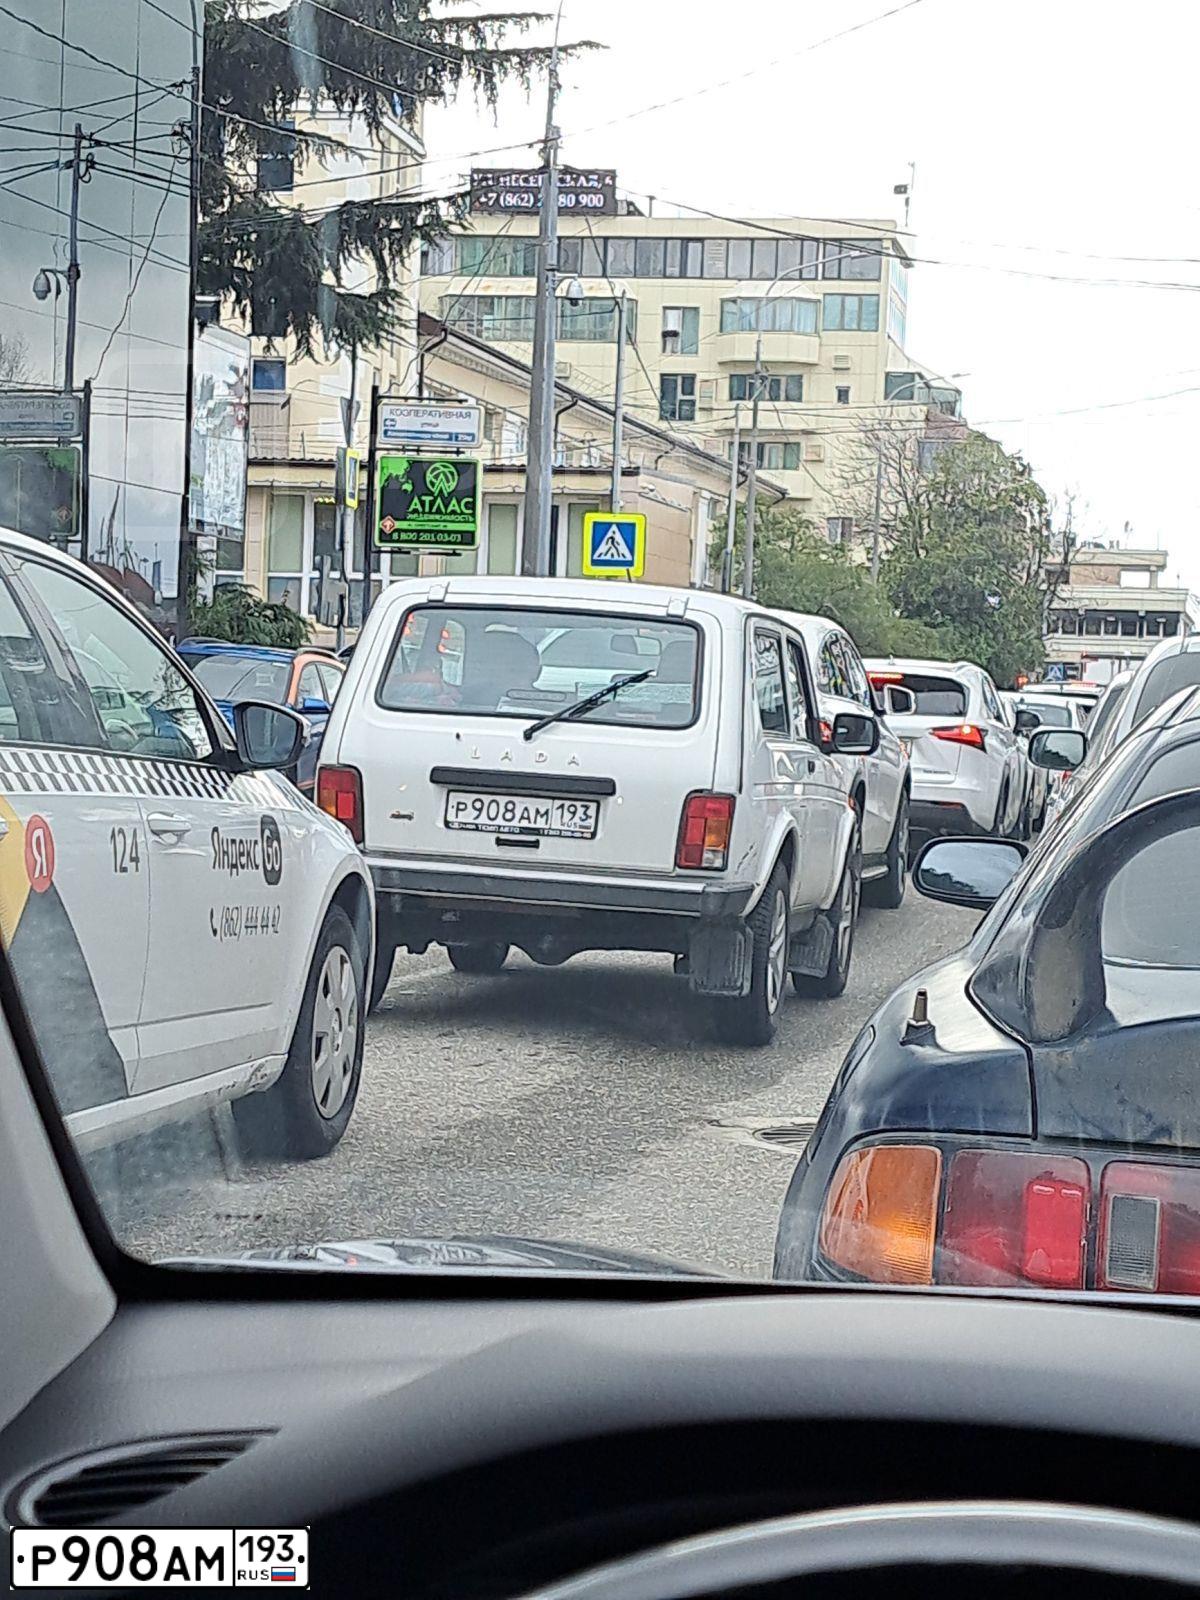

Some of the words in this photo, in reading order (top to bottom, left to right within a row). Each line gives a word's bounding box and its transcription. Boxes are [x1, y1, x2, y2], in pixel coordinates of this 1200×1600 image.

[500, 192, 534, 208] (862)
[579, 194, 604, 208] 900
[389, 408, 471, 420] КООПЕРАТИВНАЯ
[407, 495, 474, 514] АТЛАС
[471, 747, 579, 766] LADA
[456, 798, 549, 825] Р908АМ
[556, 803, 589, 822] 193
[33, 827, 48, 879] Я
[110, 827, 140, 873] 124
[211, 827, 260, 877] Яндекс
[263, 829, 280, 871] Go
[220, 906, 243, 942] (862)
